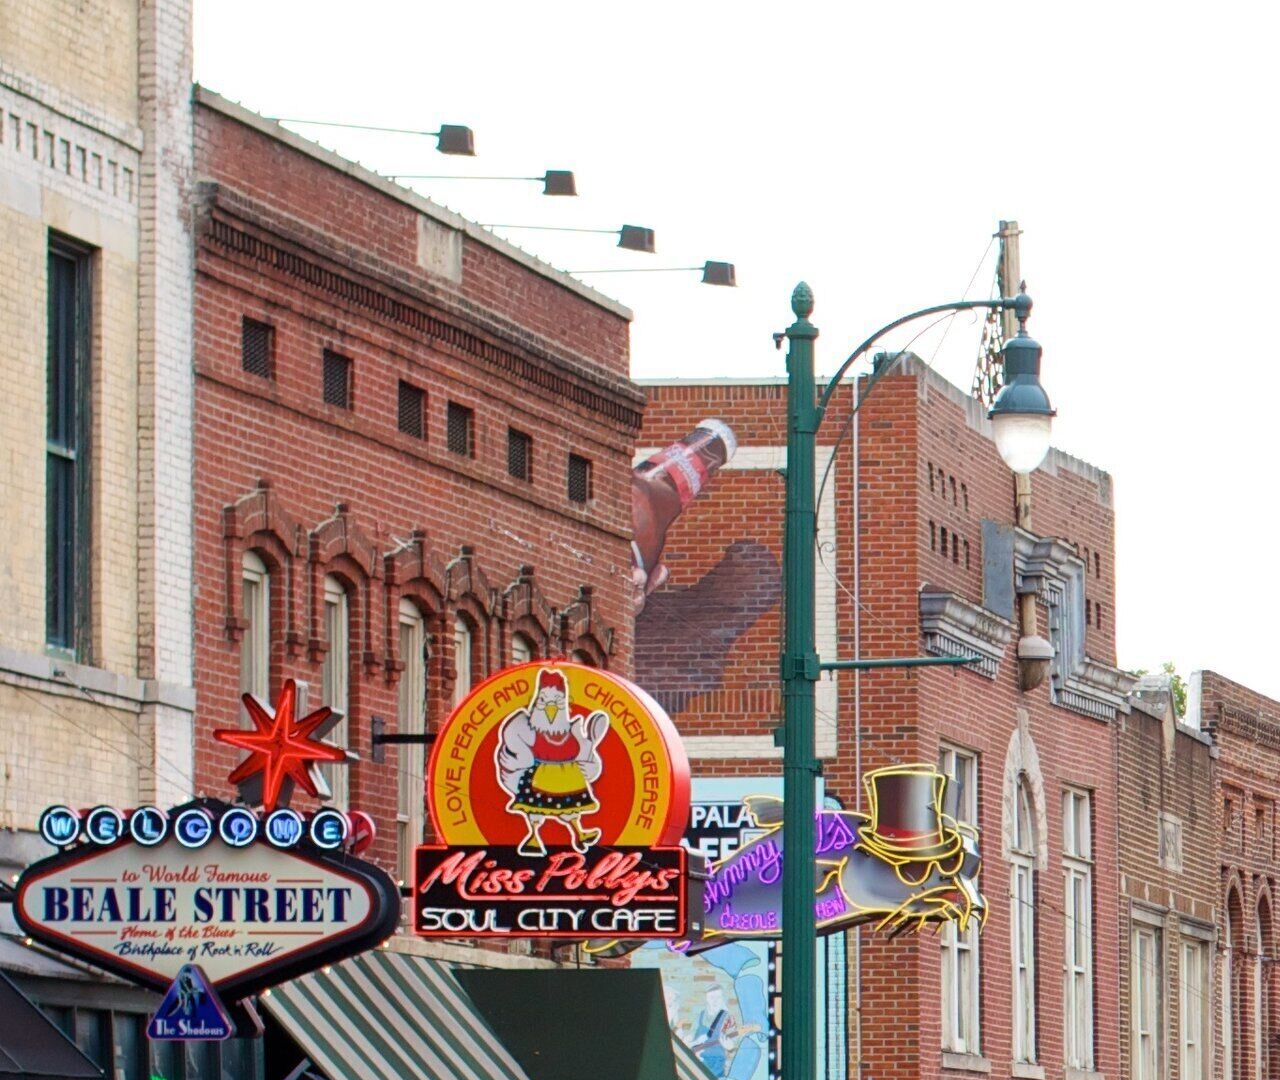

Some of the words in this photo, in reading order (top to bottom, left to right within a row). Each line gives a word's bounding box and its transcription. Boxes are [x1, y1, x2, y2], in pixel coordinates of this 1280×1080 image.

[493, 678, 529, 710] AND
[451, 701, 493, 757] PEACE
[584, 682, 648, 747] CHICKEN
[635, 751, 659, 829] GREASE
[49, 808, 343, 843] WELCOME
[691, 805, 755, 828] PALA
[121, 869, 139, 882] to
[143, 864, 199, 882] World
[205, 864, 271, 882] Famous
[421, 851, 535, 893] Miss
[42, 887, 177, 923] BEALE
[193, 887, 352, 923] STREET
[421, 908, 510, 932] SOUL
[517, 908, 586, 931] CITY
[591, 908, 676, 931] CAFE
[121, 926, 162, 940] Home
[165, 927, 176, 941] of
[178, 926, 200, 939] the
[202, 926, 238, 939] Blues
[117, 943, 182, 960] Birthplace
[187, 944, 198, 960] of
[201, 943, 232, 957] Rock
[245, 942, 278, 956] Roll
[156, 1020, 175, 1036] The
[178, 1019, 225, 1037] Shadows
